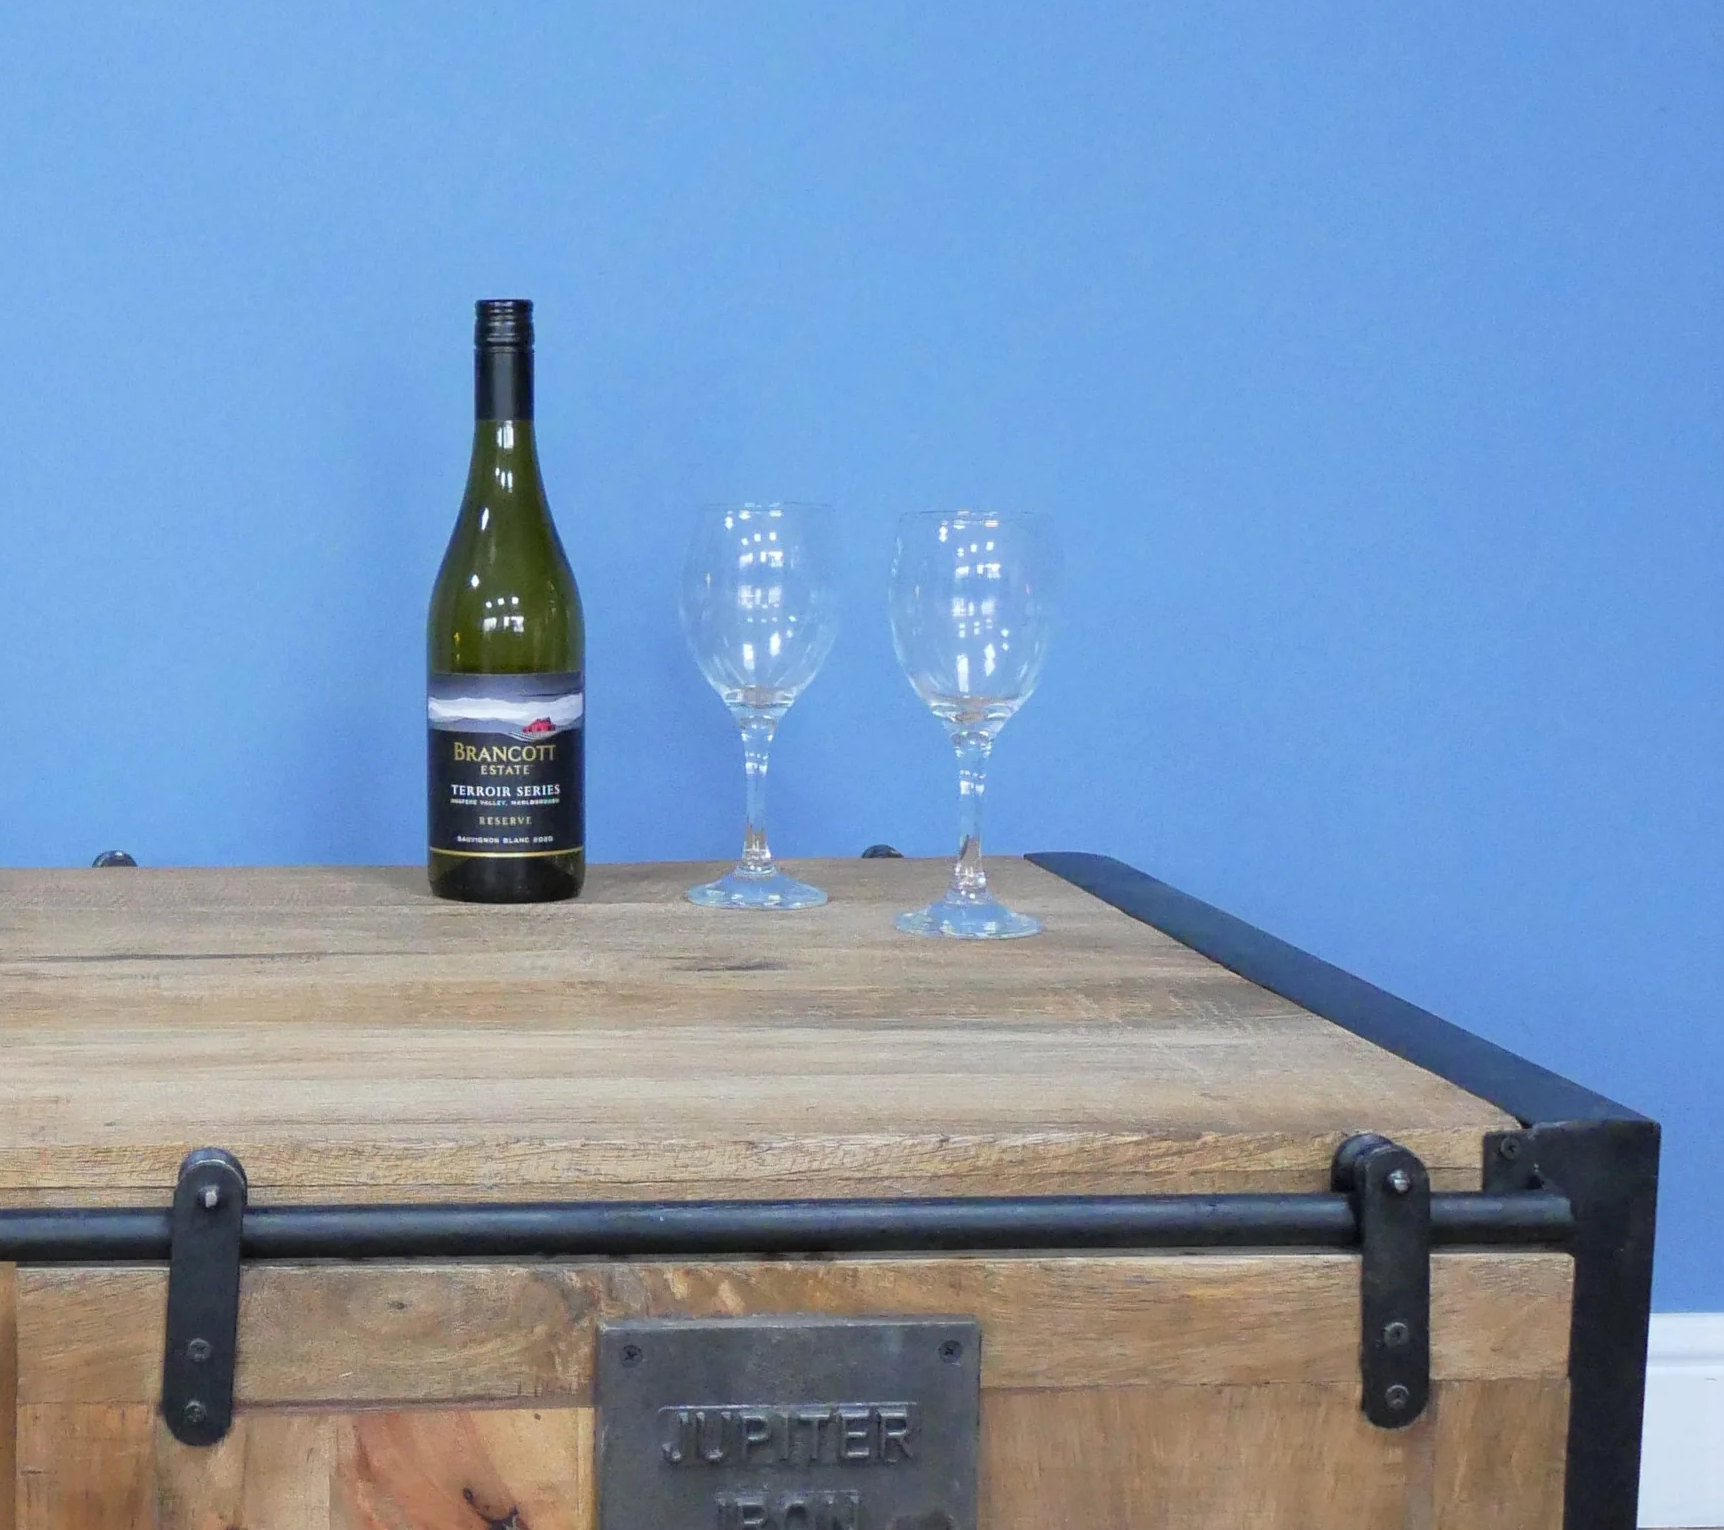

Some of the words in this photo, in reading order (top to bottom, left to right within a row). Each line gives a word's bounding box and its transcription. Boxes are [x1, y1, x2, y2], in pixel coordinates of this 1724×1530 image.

[453, 741, 556, 762] BRANCOTT
[480, 764, 530, 775] ESTATE
[451, 784, 512, 797] TERROIR
[516, 784, 560, 797] SERIES
[478, 816, 532, 825] RESERVE
[457, 835, 500, 843] SAUVIGNON
[502, 836, 530, 844] BLANC
[660, 1405, 916, 1467] JUPITER
